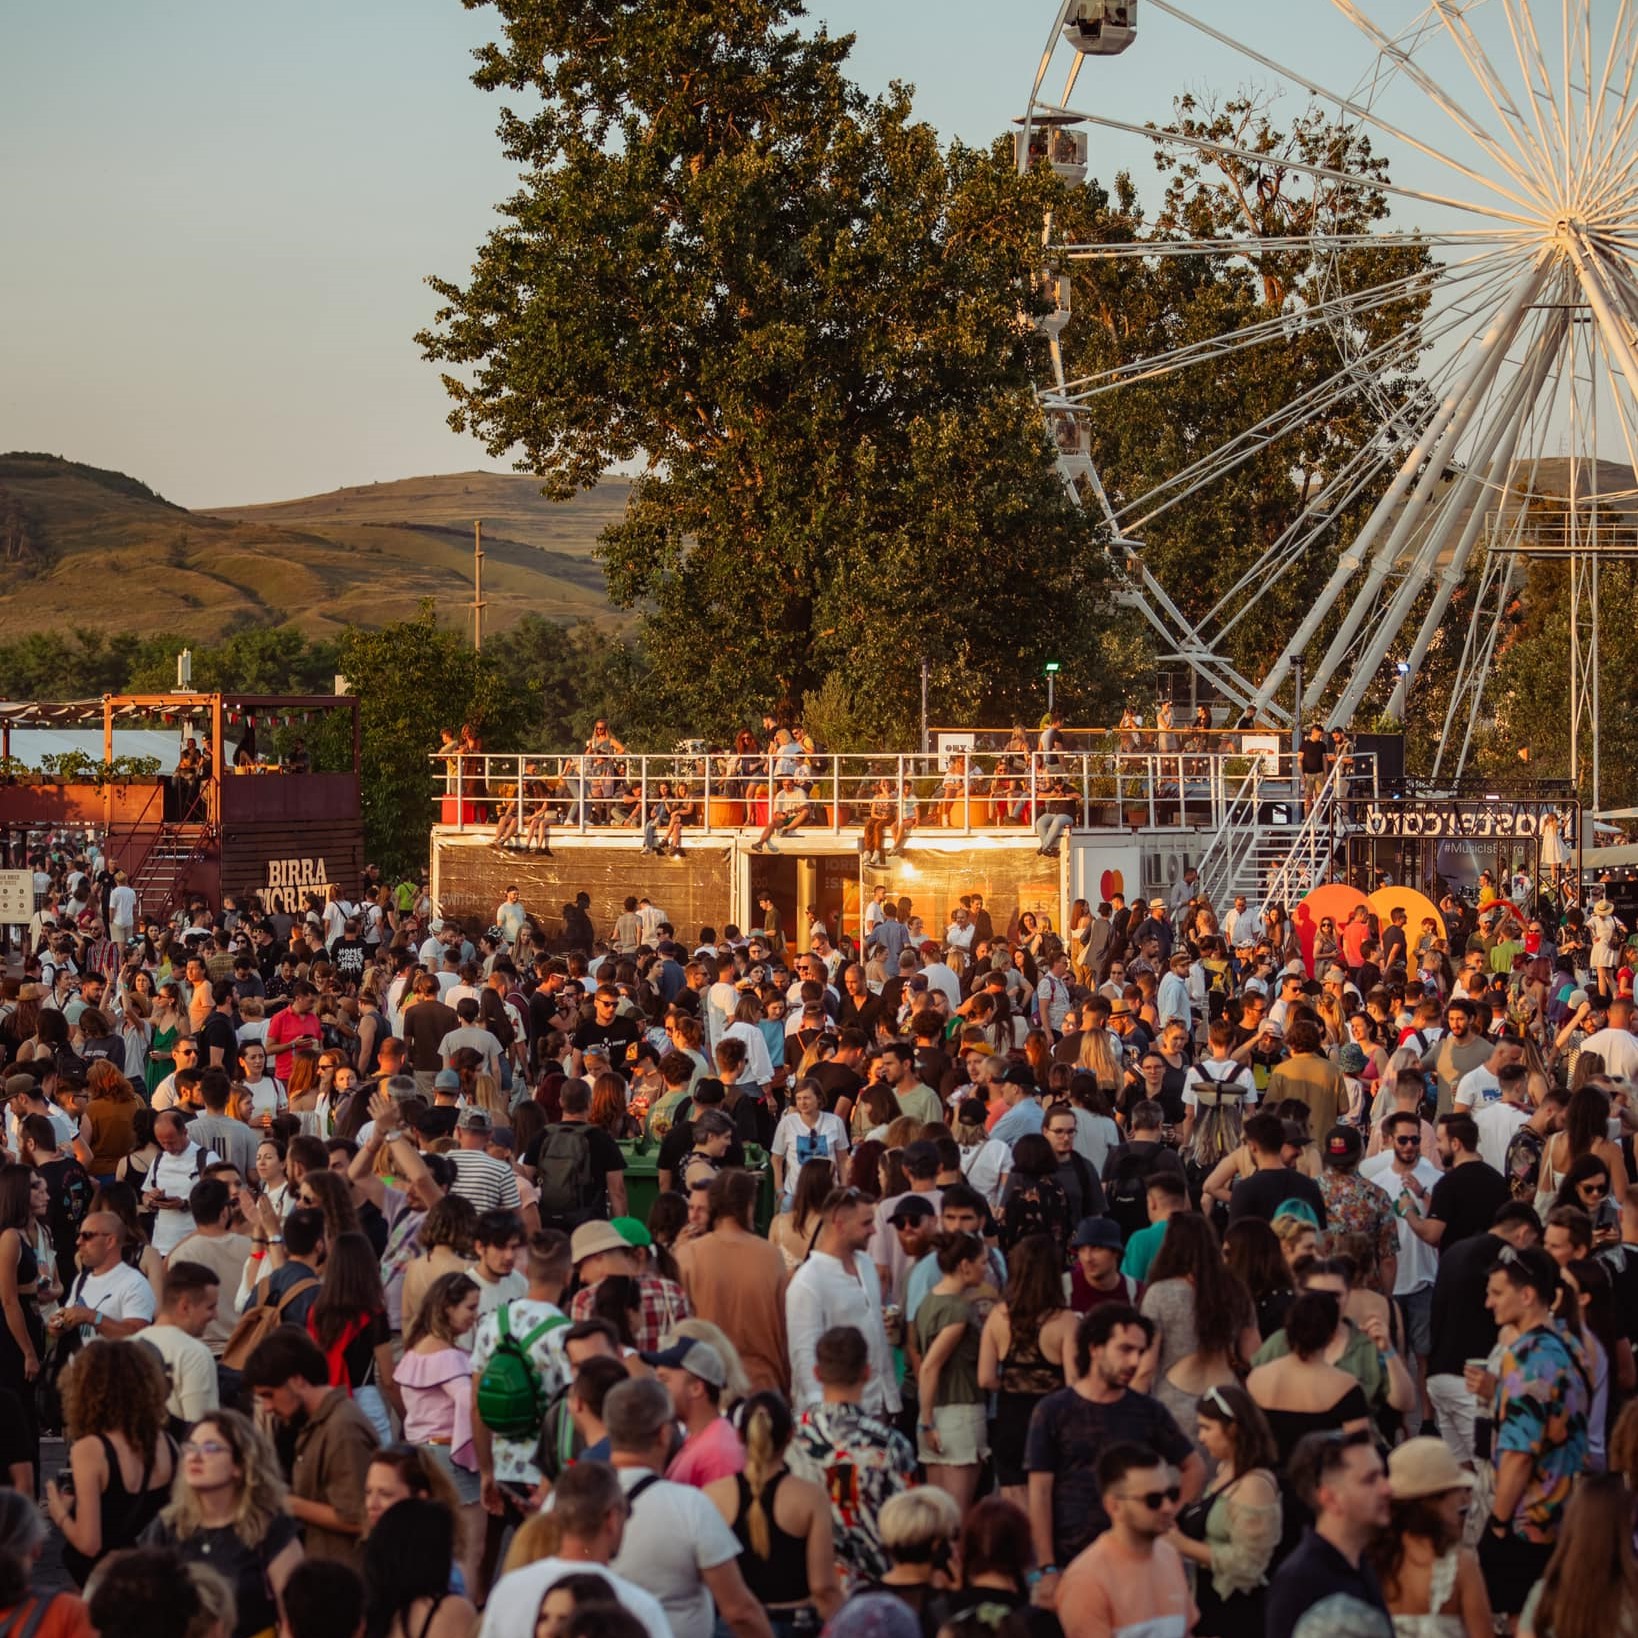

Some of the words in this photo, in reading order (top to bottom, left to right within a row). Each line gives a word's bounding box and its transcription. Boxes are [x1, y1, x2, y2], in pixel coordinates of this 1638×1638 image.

[268, 858, 328, 887] BIRRA
[255, 883, 340, 915] MORETT
[337, 947, 363, 956] HOME
